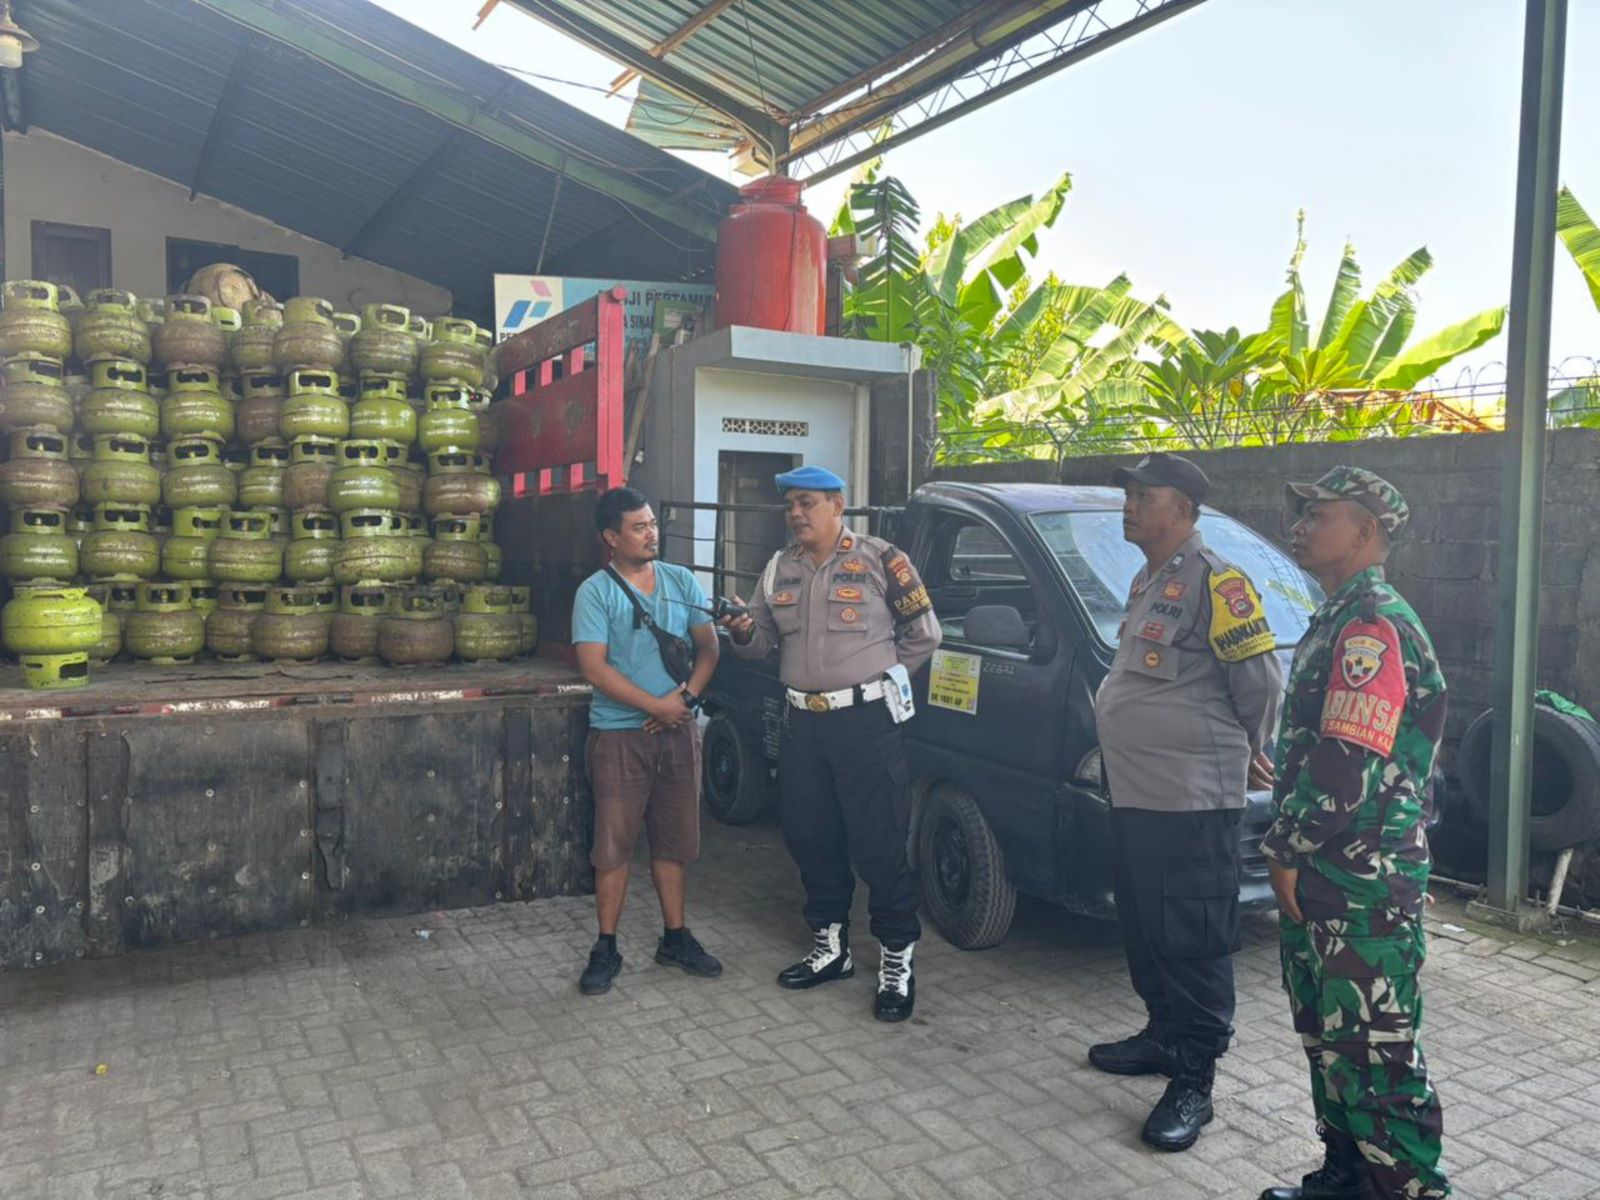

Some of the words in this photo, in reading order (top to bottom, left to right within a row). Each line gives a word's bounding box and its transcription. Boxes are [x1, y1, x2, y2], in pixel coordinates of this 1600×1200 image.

[833, 572, 867, 583] POLRI
[1150, 602, 1184, 620] POLRI
[1328, 720, 1375, 742] SAMBIAN
